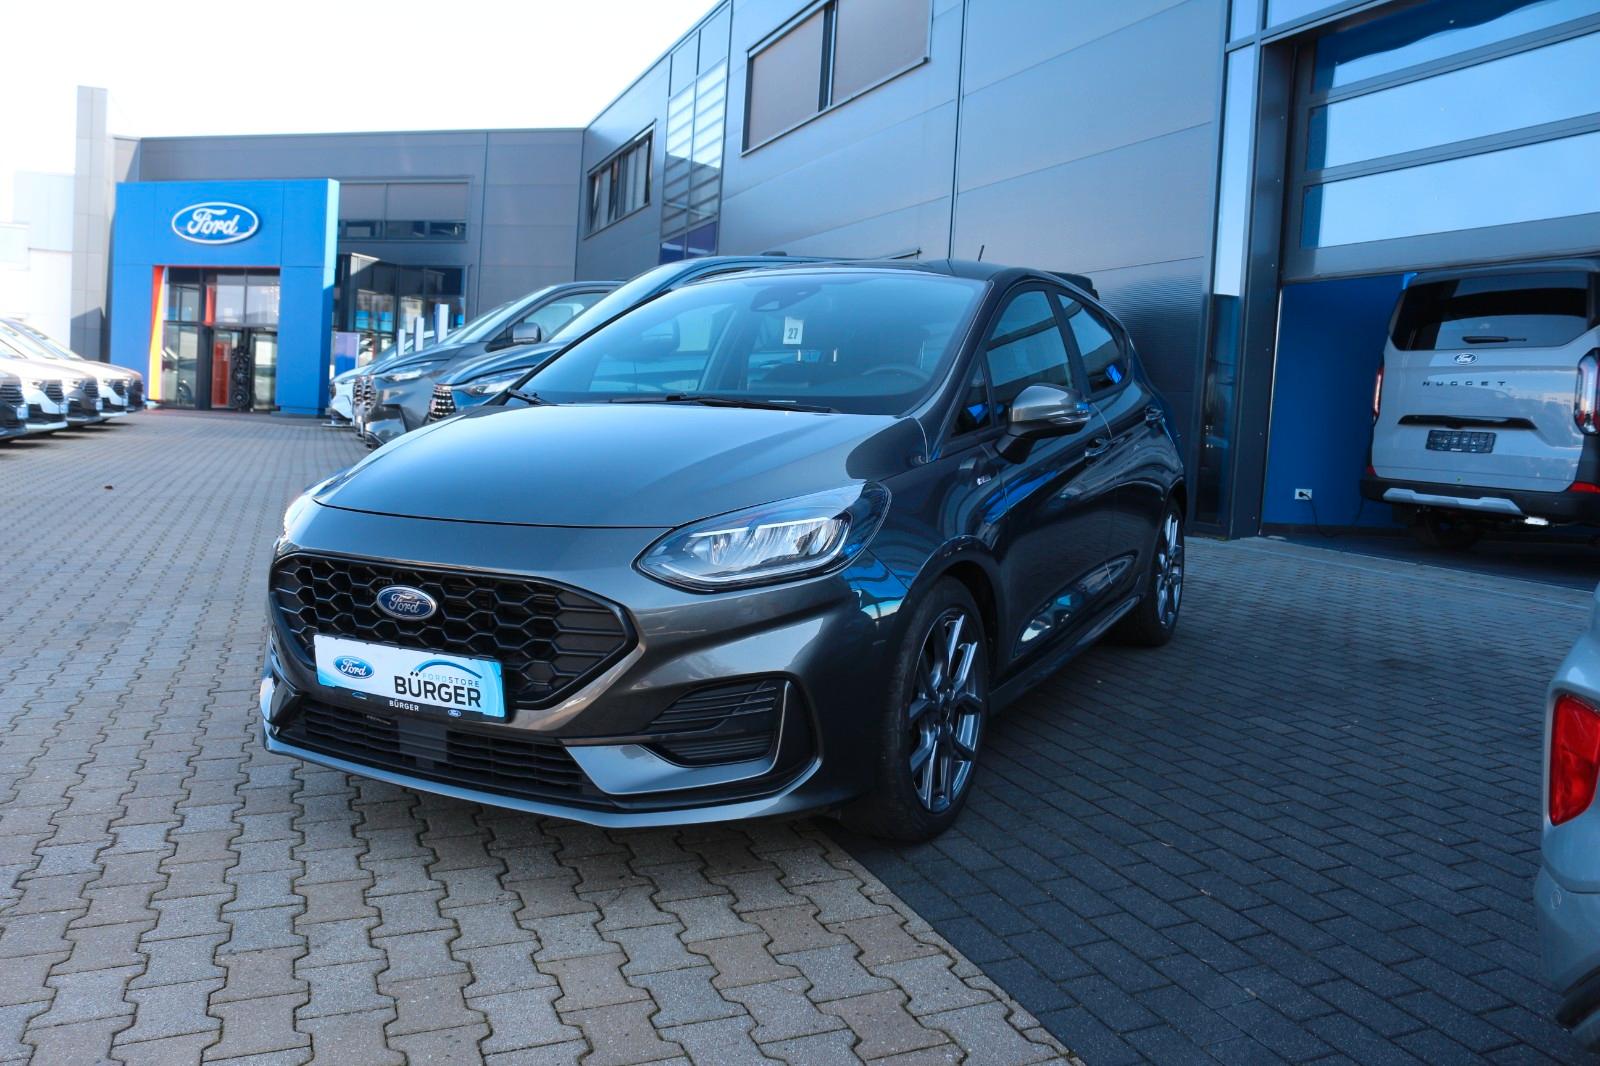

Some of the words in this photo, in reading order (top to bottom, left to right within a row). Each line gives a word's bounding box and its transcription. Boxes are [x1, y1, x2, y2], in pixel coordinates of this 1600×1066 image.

[187, 208, 240, 234] Ford
[787, 327, 799, 340] 27
[388, 593, 420, 613] Ford
[340, 659, 367, 676] Ford
[394, 671, 481, 708] BÜRGER
[388, 699, 420, 712] BÜRGER
